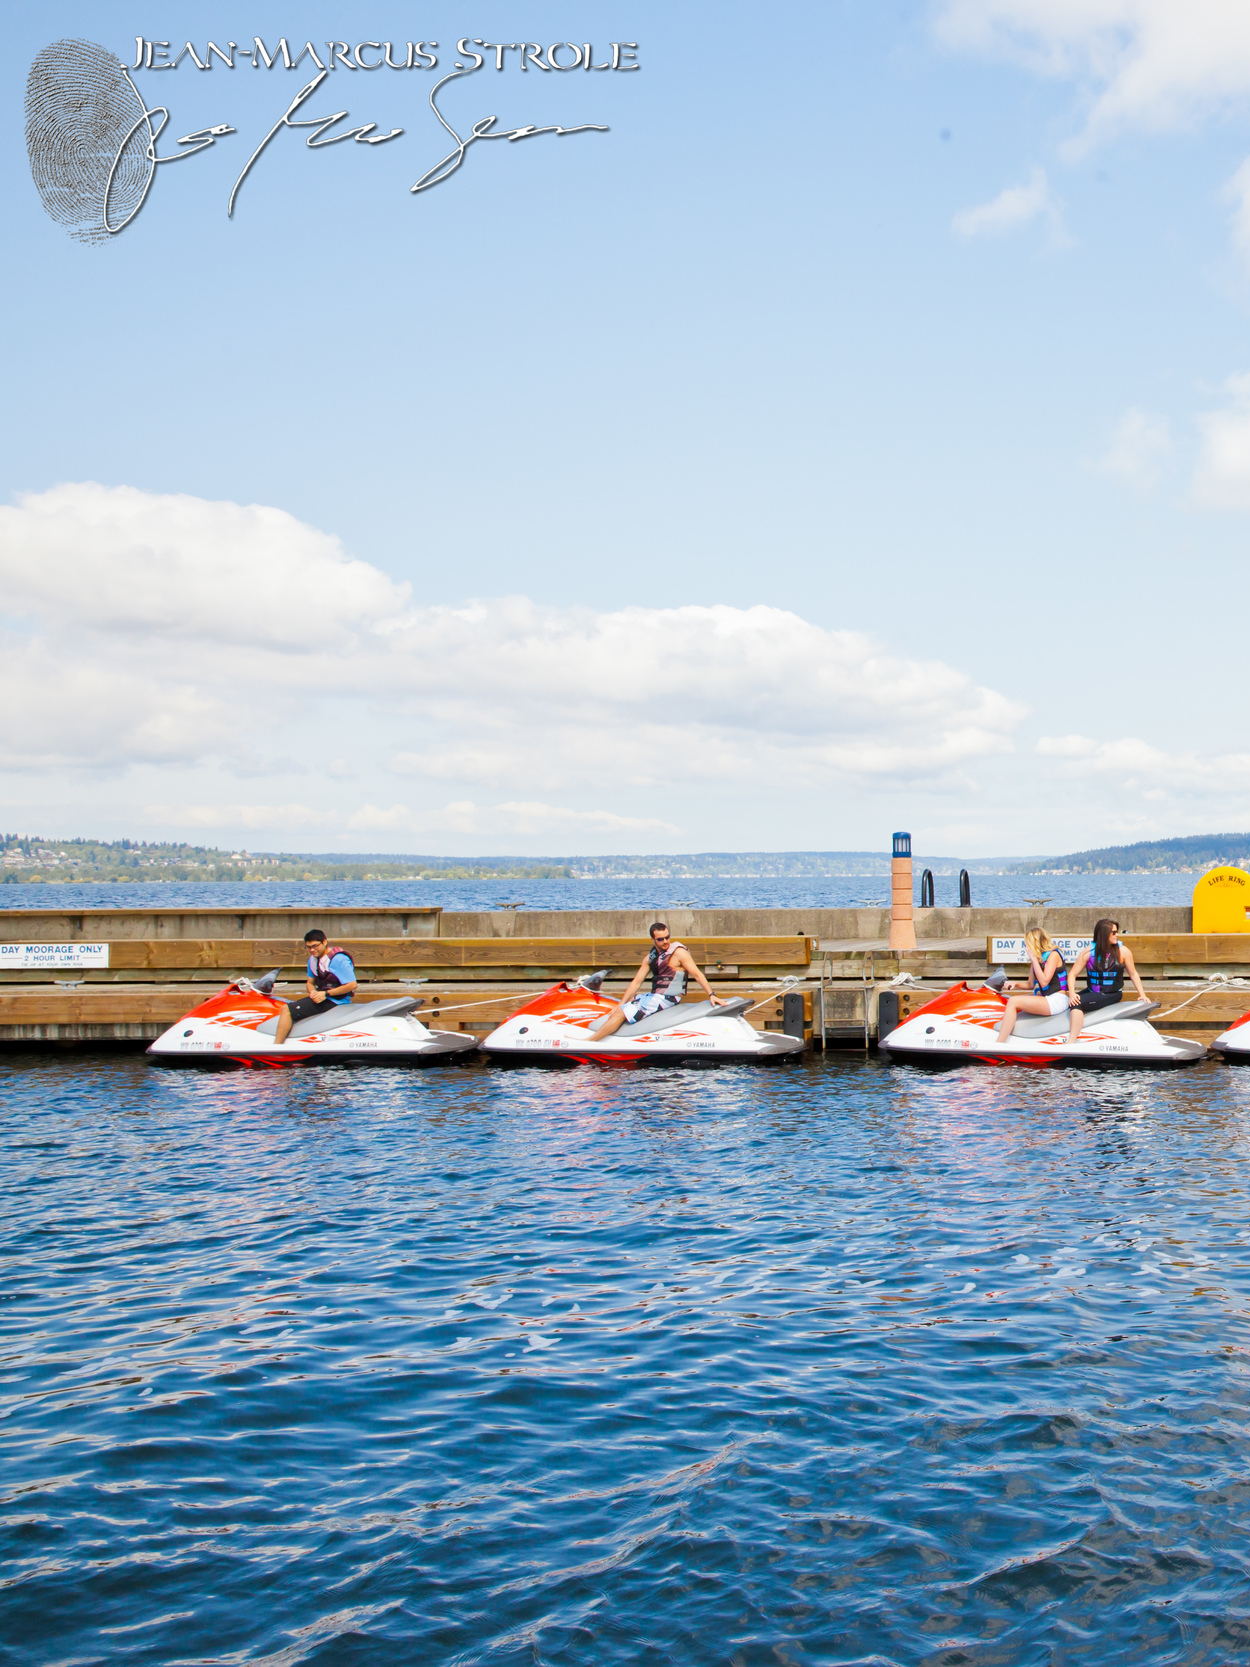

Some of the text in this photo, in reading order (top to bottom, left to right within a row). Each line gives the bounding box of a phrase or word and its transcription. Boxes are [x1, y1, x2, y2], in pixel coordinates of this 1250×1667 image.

[1208, 875, 1246, 886] LIFE RING
[997, 940, 1016, 949] DAY
[1, 945, 103, 954] DAY MOORAGE ONLY
